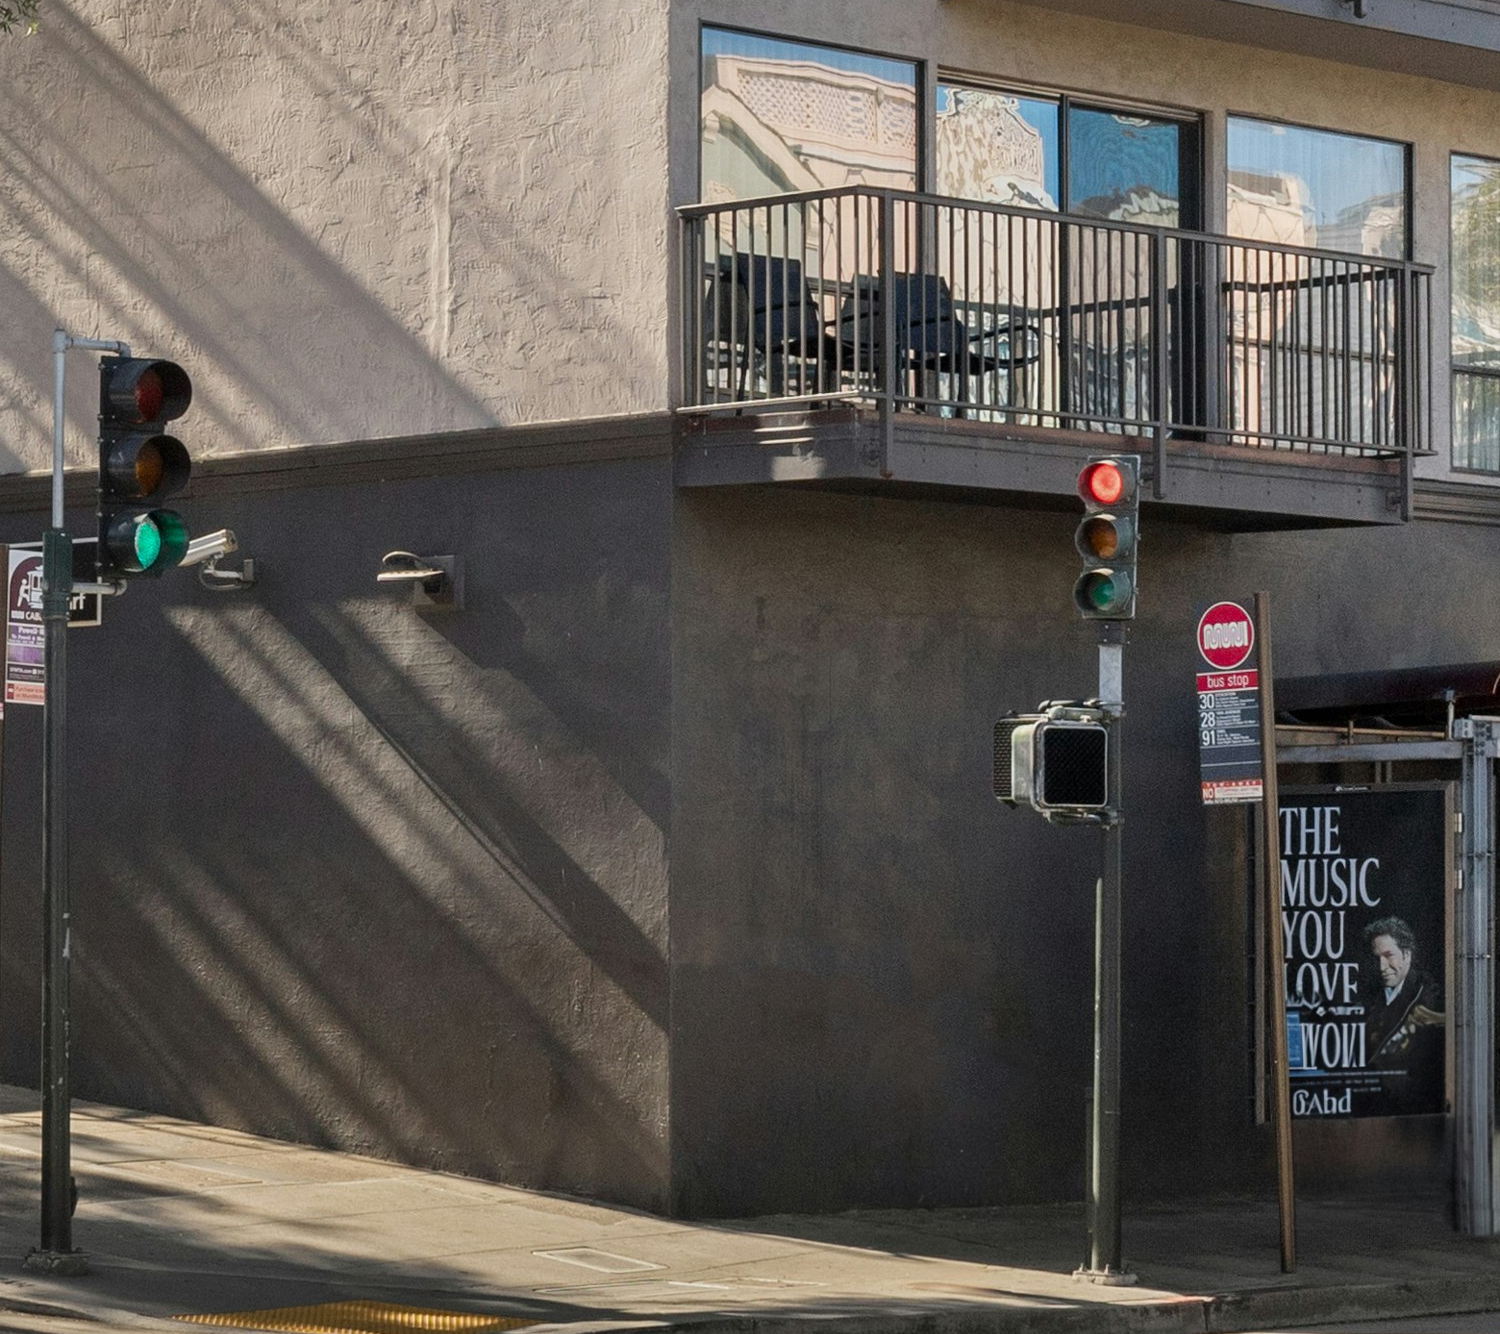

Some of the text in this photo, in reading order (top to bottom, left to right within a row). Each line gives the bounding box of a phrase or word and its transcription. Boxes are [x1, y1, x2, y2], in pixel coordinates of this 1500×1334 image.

[25, 611, 42, 621] CAB
[1207, 674, 1249, 688] bus stop
[1199, 694, 1214, 709] 30
[1200, 712, 1215, 727] 28
[1202, 730, 1216, 746] 91
[1279, 806, 1341, 856] THE
[1280, 857, 1381, 907] MUSIC
[1282, 910, 1345, 960] YOU
